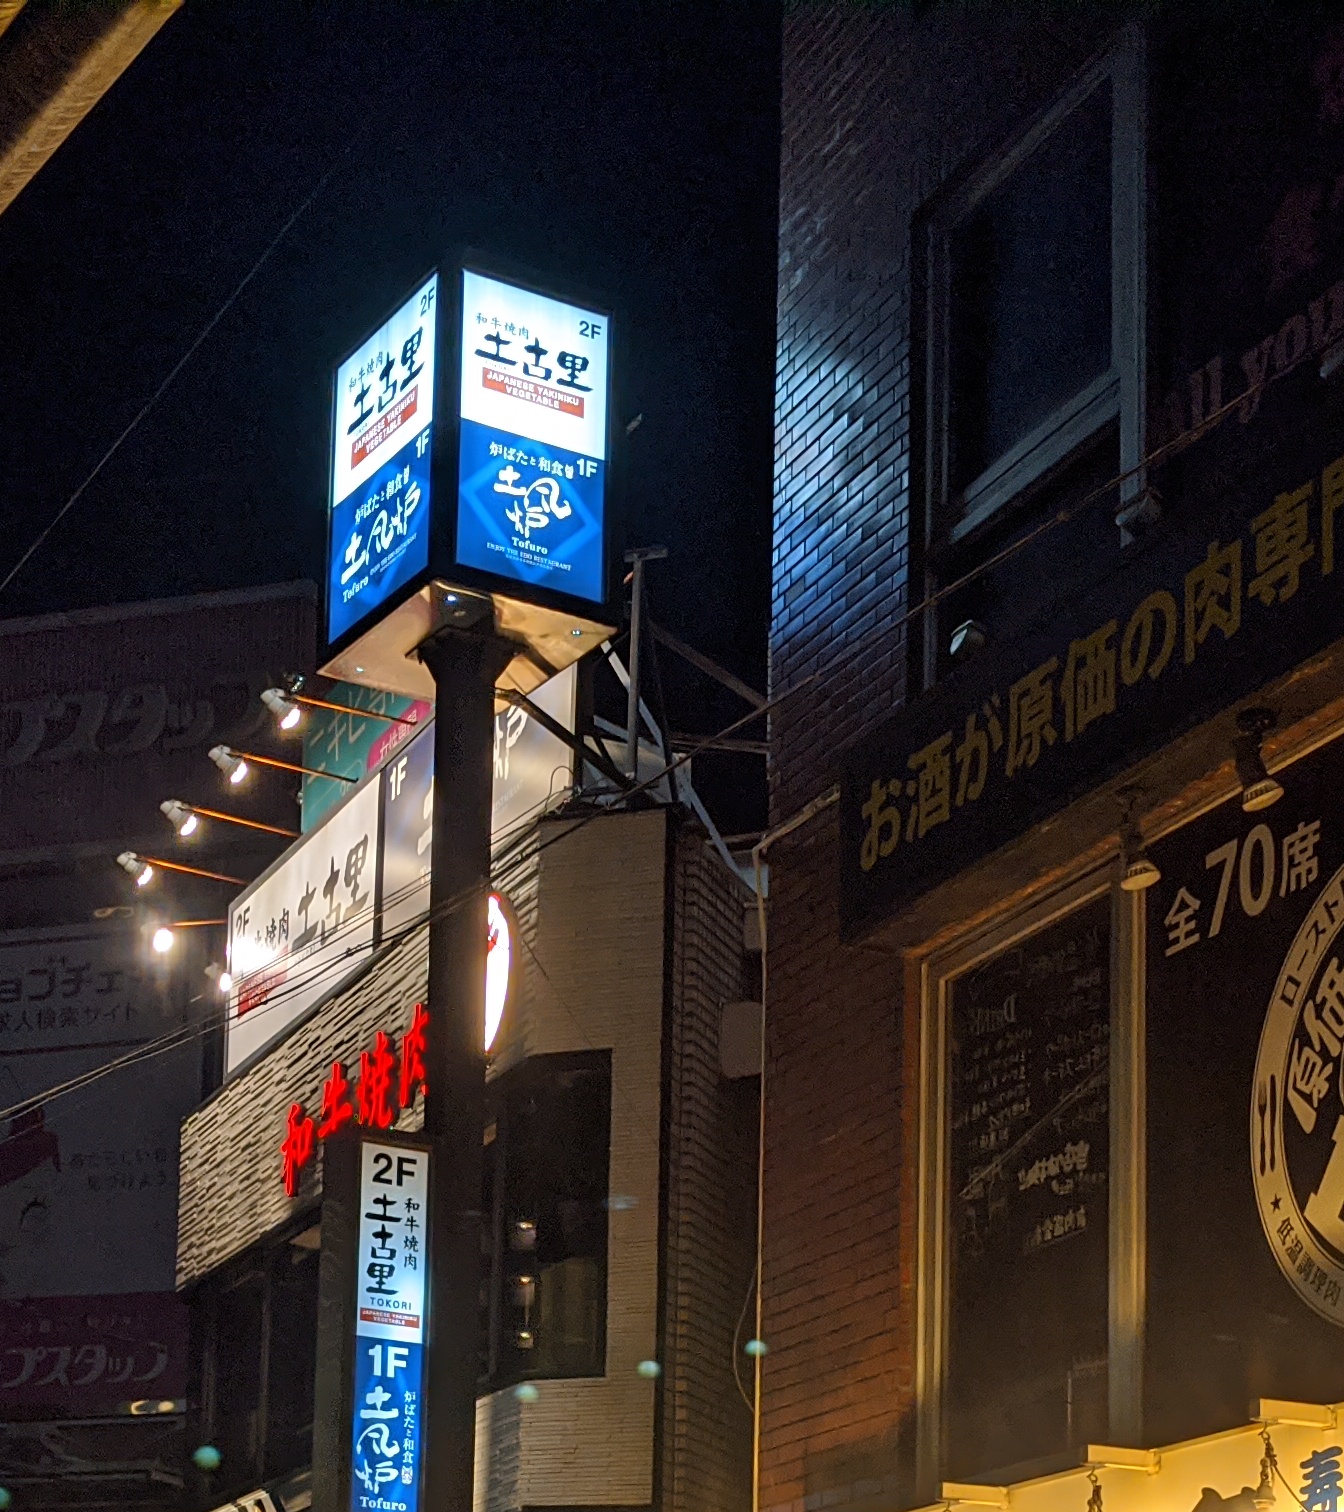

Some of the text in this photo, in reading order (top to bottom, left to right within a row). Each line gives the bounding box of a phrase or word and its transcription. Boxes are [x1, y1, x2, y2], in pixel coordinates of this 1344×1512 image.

[421, 286, 435, 317] 2F
[476, 312, 529, 340] 和牛焼肉
[579, 320, 601, 339] 2F
[474, 331, 593, 392] 土古里
[347, 326, 425, 435] 土古里
[486, 370, 580, 406] JAPANESE YAKINIKU
[505, 385, 560, 409] VEGETABLE
[416, 429, 429, 458] 1F
[577, 459, 597, 477] 1F
[512, 537, 548, 555] Tofuro
[343, 576, 368, 602] Tofuro
[390, 757, 408, 800] 1F
[292, 834, 369, 949] 土古里
[1164, 816, 1322, 957] 全70席
[235, 906, 251, 937] 2F
[281, 1002, 430, 1197] 和牛焼肉
[372, 1153, 417, 1187] 2F
[365, 1193, 402, 1295] 土古里
[403, 1196, 420, 1271] 和牛焼肉
[1277, 1217, 1341, 1306] 低温調理肉
[369, 1297, 413, 1311] TOKORI
[368, 1343, 409, 1379] 1F
[402, 1390, 416, 1464] 炉ばたと和食
[360, 1496, 407, 1512] Tofuro
